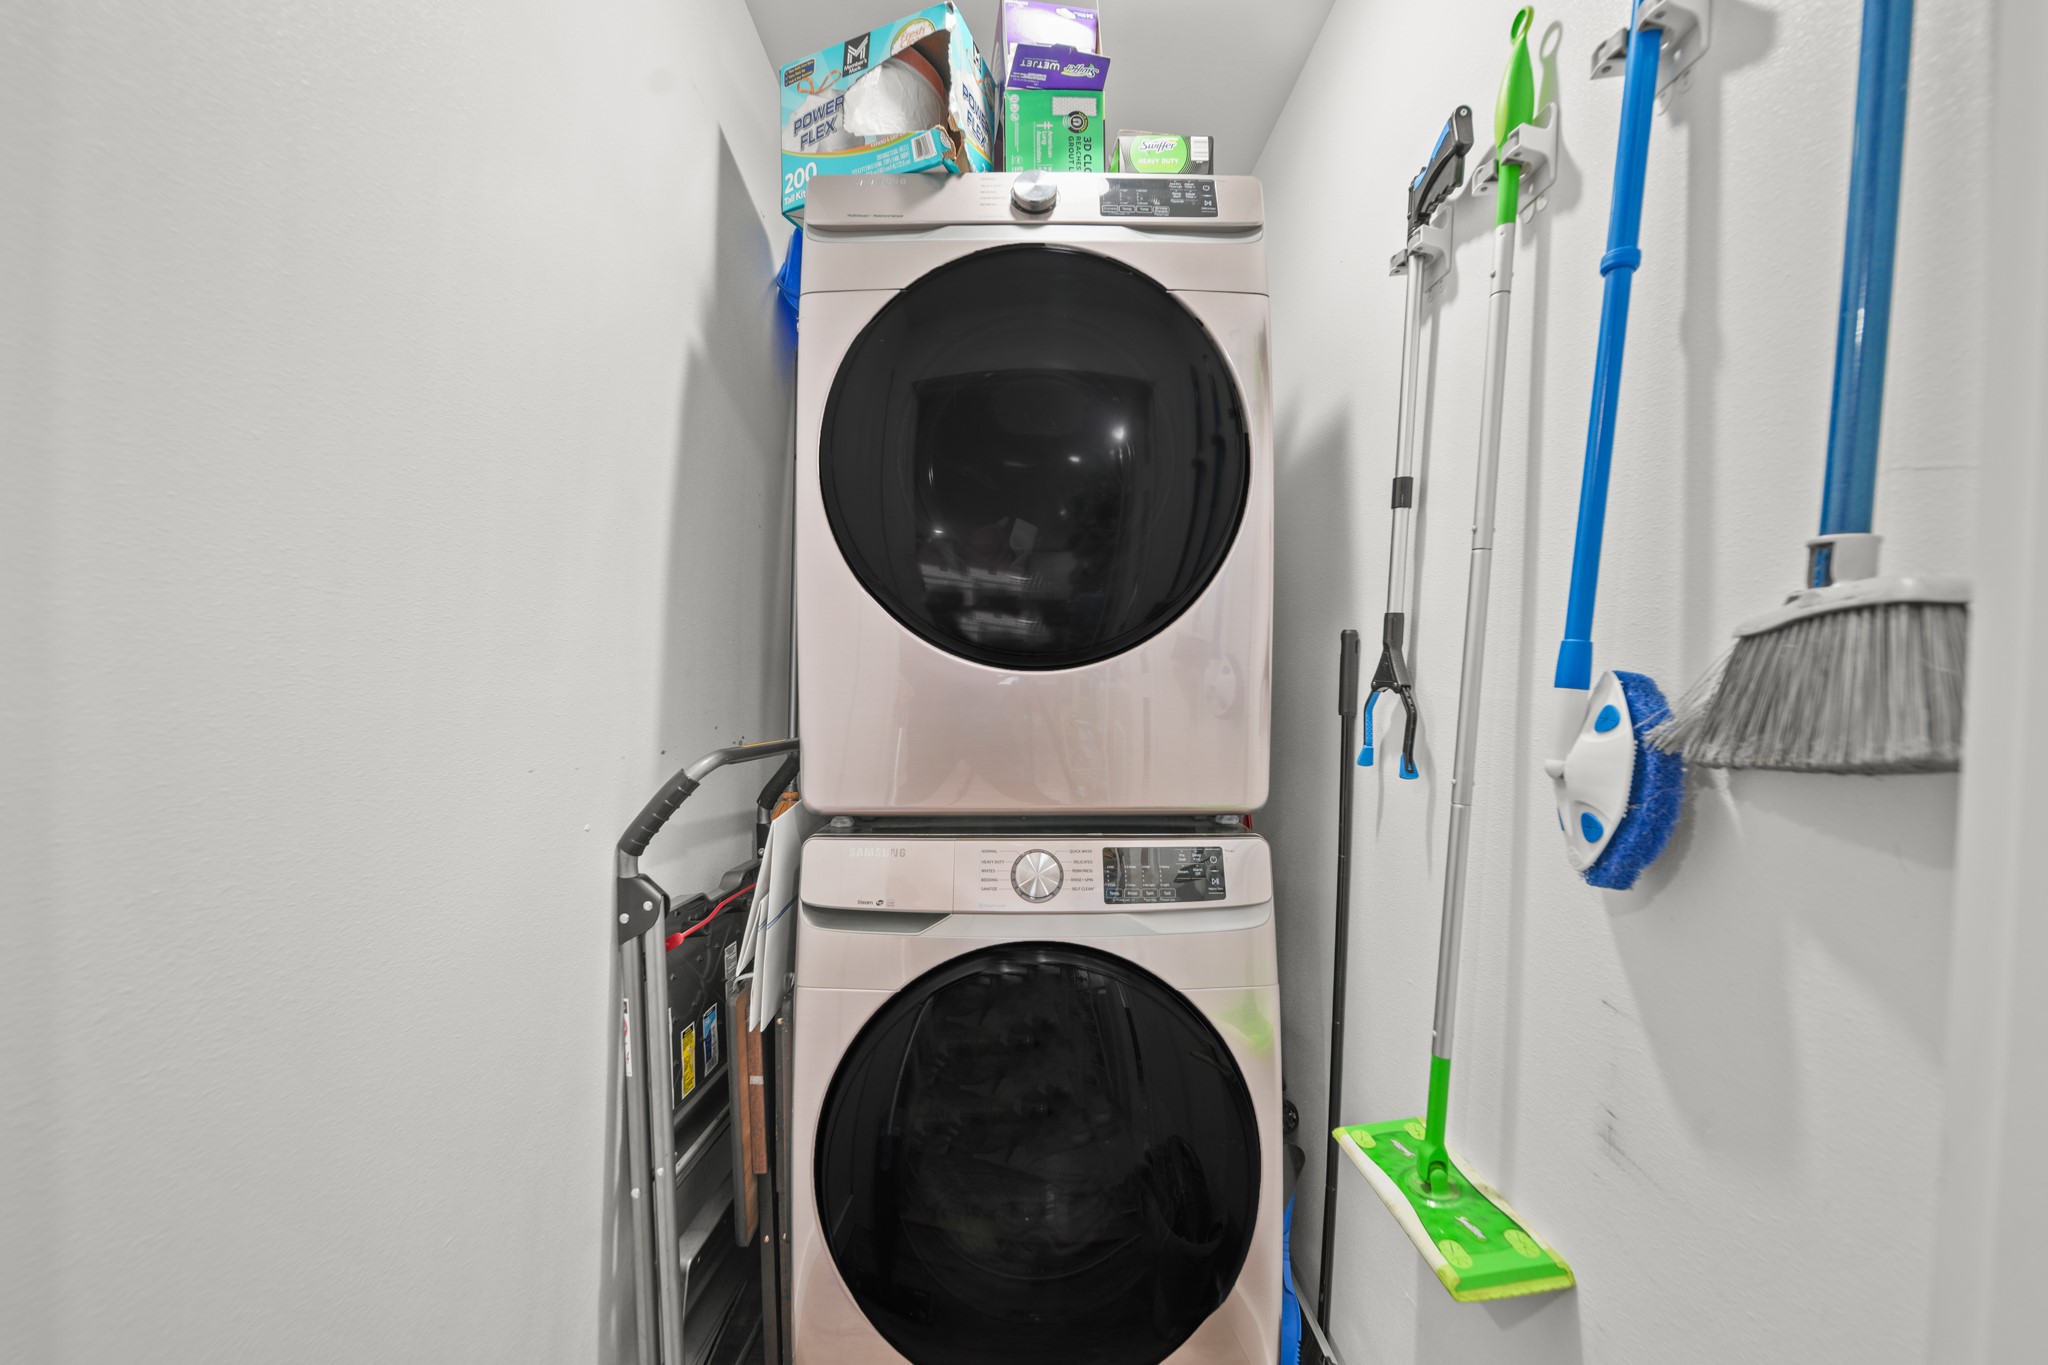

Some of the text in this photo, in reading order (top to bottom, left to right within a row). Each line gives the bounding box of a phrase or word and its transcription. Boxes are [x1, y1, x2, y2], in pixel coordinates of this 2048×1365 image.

[1020, 59, 1060, 71] WETJET
[1061, 63, 1099, 78] Swiffer
[793, 94, 845, 136] POWER
[962, 82, 989, 134] POWER
[800, 113, 838, 150] FLEX
[967, 109, 987, 148] FLEX
[1083, 136, 1092, 152] 3D
[1139, 139, 1177, 153] Swiffer
[784, 161, 818, 195] 200
[784, 192, 795, 206] Tall
[849, 847, 906, 858] SAMSUNG
